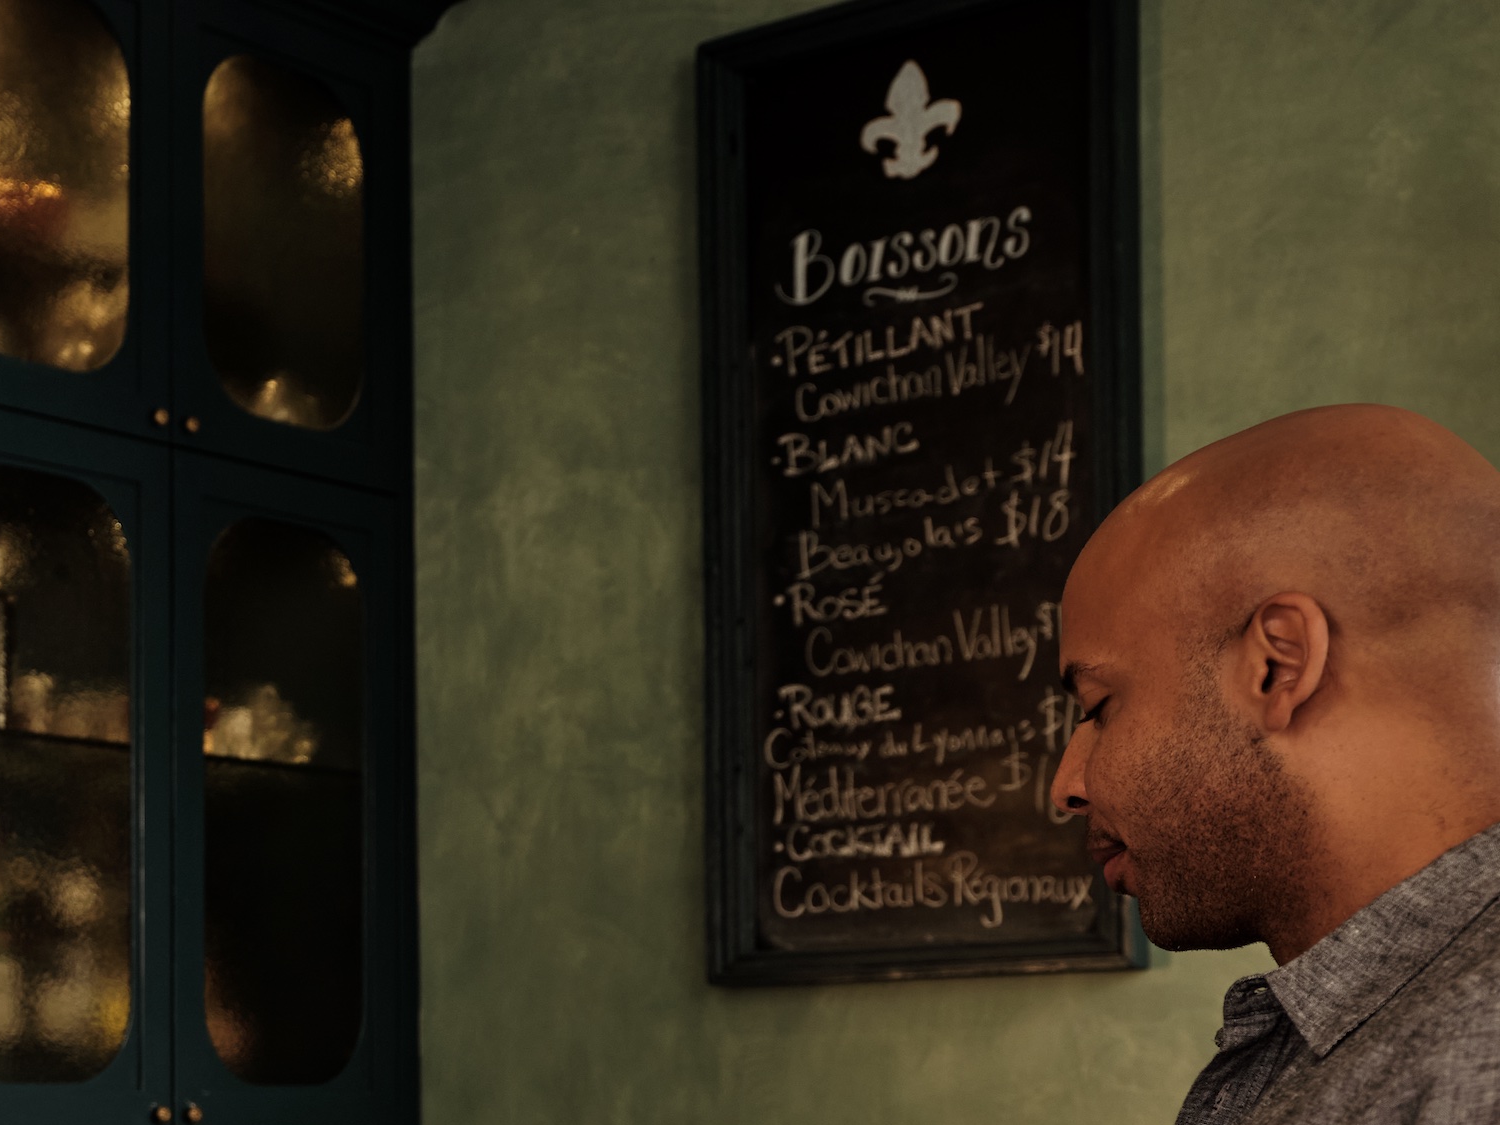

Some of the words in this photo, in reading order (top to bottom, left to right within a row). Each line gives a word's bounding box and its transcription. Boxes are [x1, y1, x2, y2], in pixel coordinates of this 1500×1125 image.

[777, 302, 985, 377] PÉTILLANT
[944, 333, 1033, 406] Valley
[777, 421, 920, 477] BLANC
[1010, 419, 1077, 490] $14
[996, 489, 1071, 549] $18
[953, 603, 1037, 681] Valley
[1035, 600, 1062, 641] $1
[778, 683, 902, 730] ROUGE
[1037, 685, 1084, 753] $1
[772, 860, 949, 918] Cocktails
